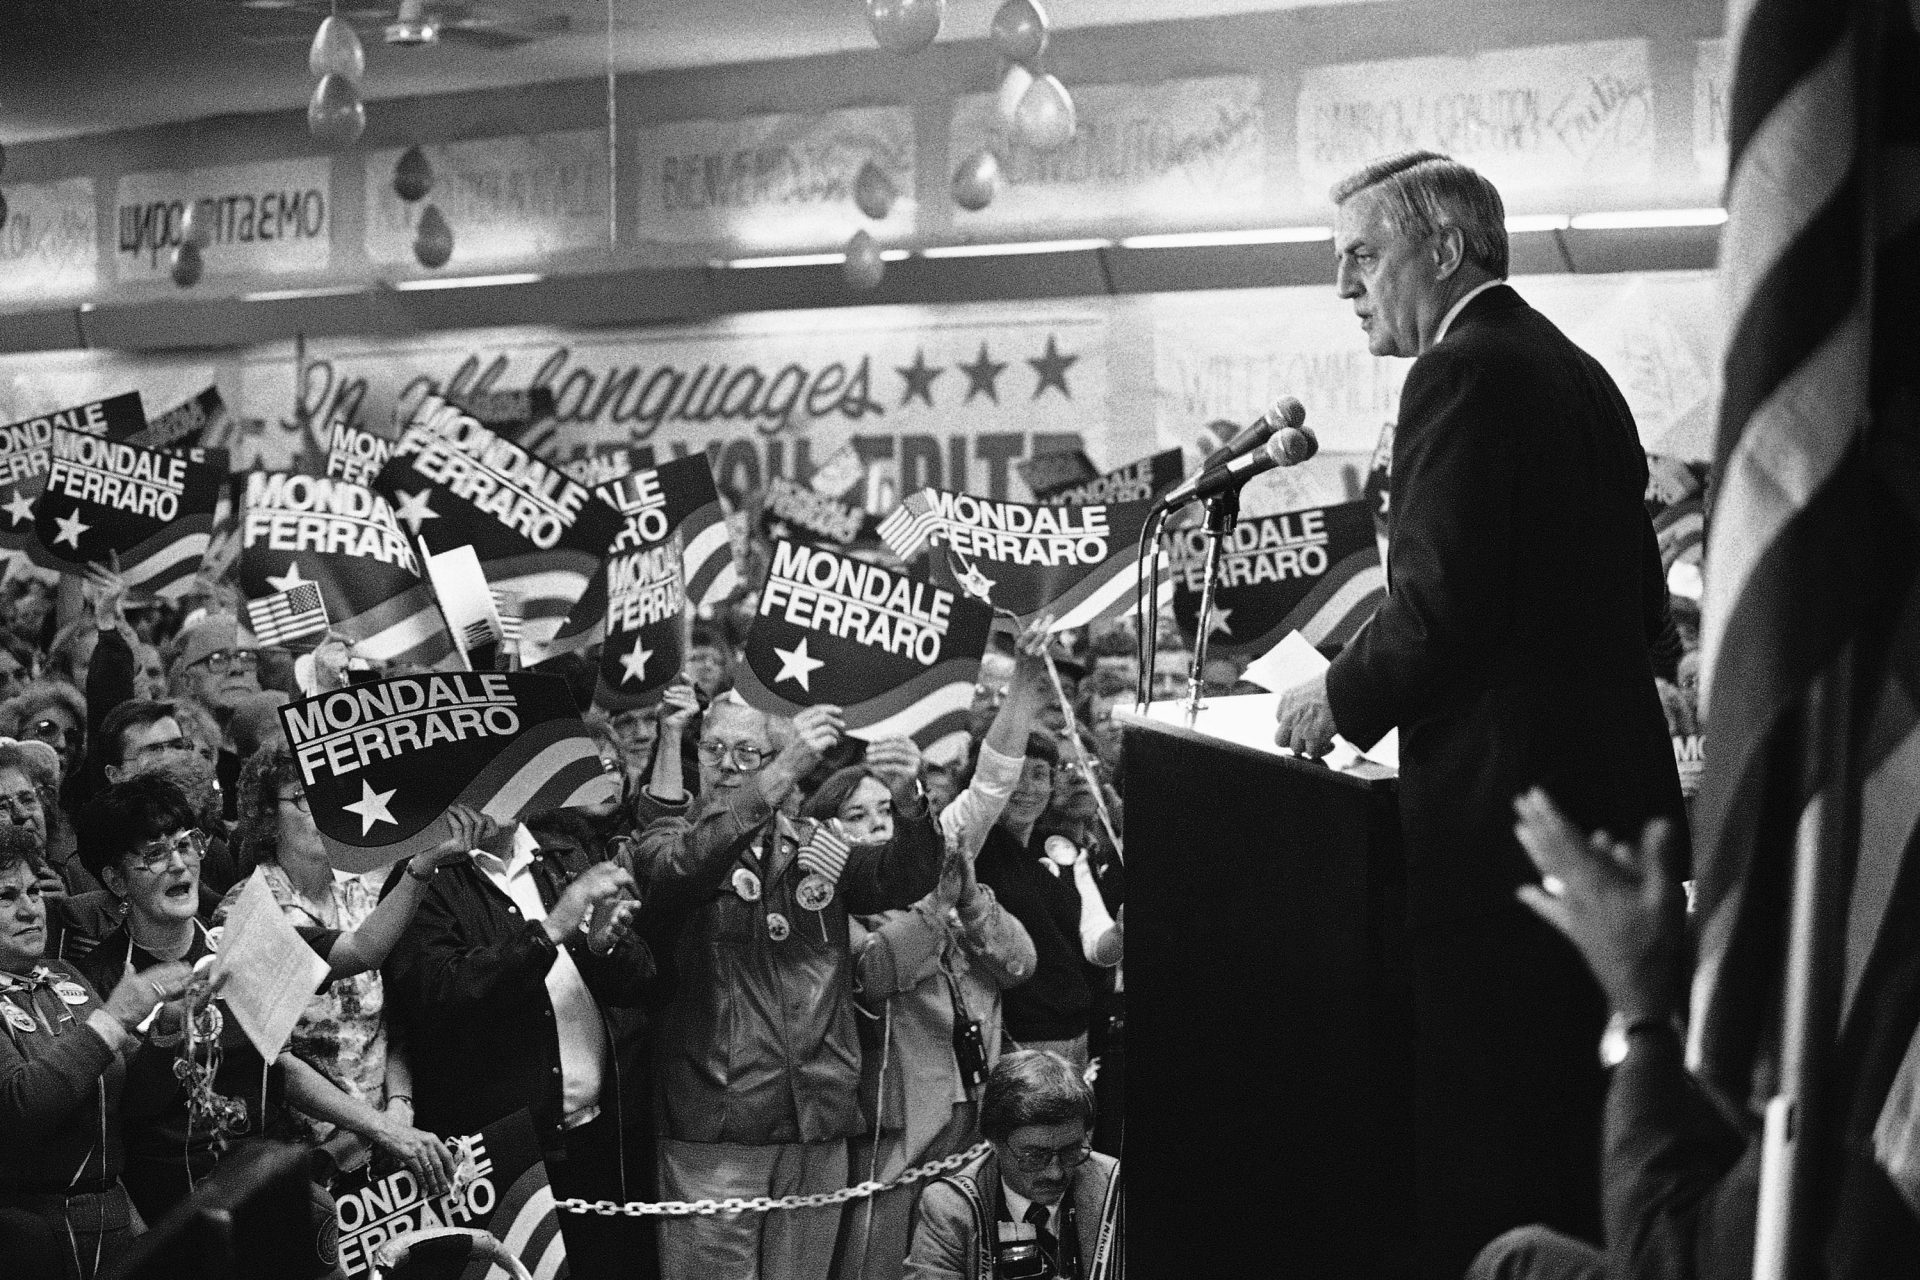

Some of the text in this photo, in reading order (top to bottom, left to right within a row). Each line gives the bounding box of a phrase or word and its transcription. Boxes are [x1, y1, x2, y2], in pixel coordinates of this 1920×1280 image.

[0, 403, 108, 452] ONDALE
[53, 428, 187, 490] MONDALE
[412, 395, 590, 523] MONDALE
[47, 462, 178, 521] FERRARO
[392, 427, 563, 549] FERRARO
[926, 487, 1110, 535] MONDALE
[244, 514, 421, 578] FERRARO
[771, 540, 954, 630] MONDALE
[759, 580, 941, 666] FERRARO
[284, 674, 516, 745] MONDALE
[296, 705, 520, 786] FERRARO
[335, 1132, 492, 1232] ONDE
[338, 1177, 496, 1277] ERRARO
